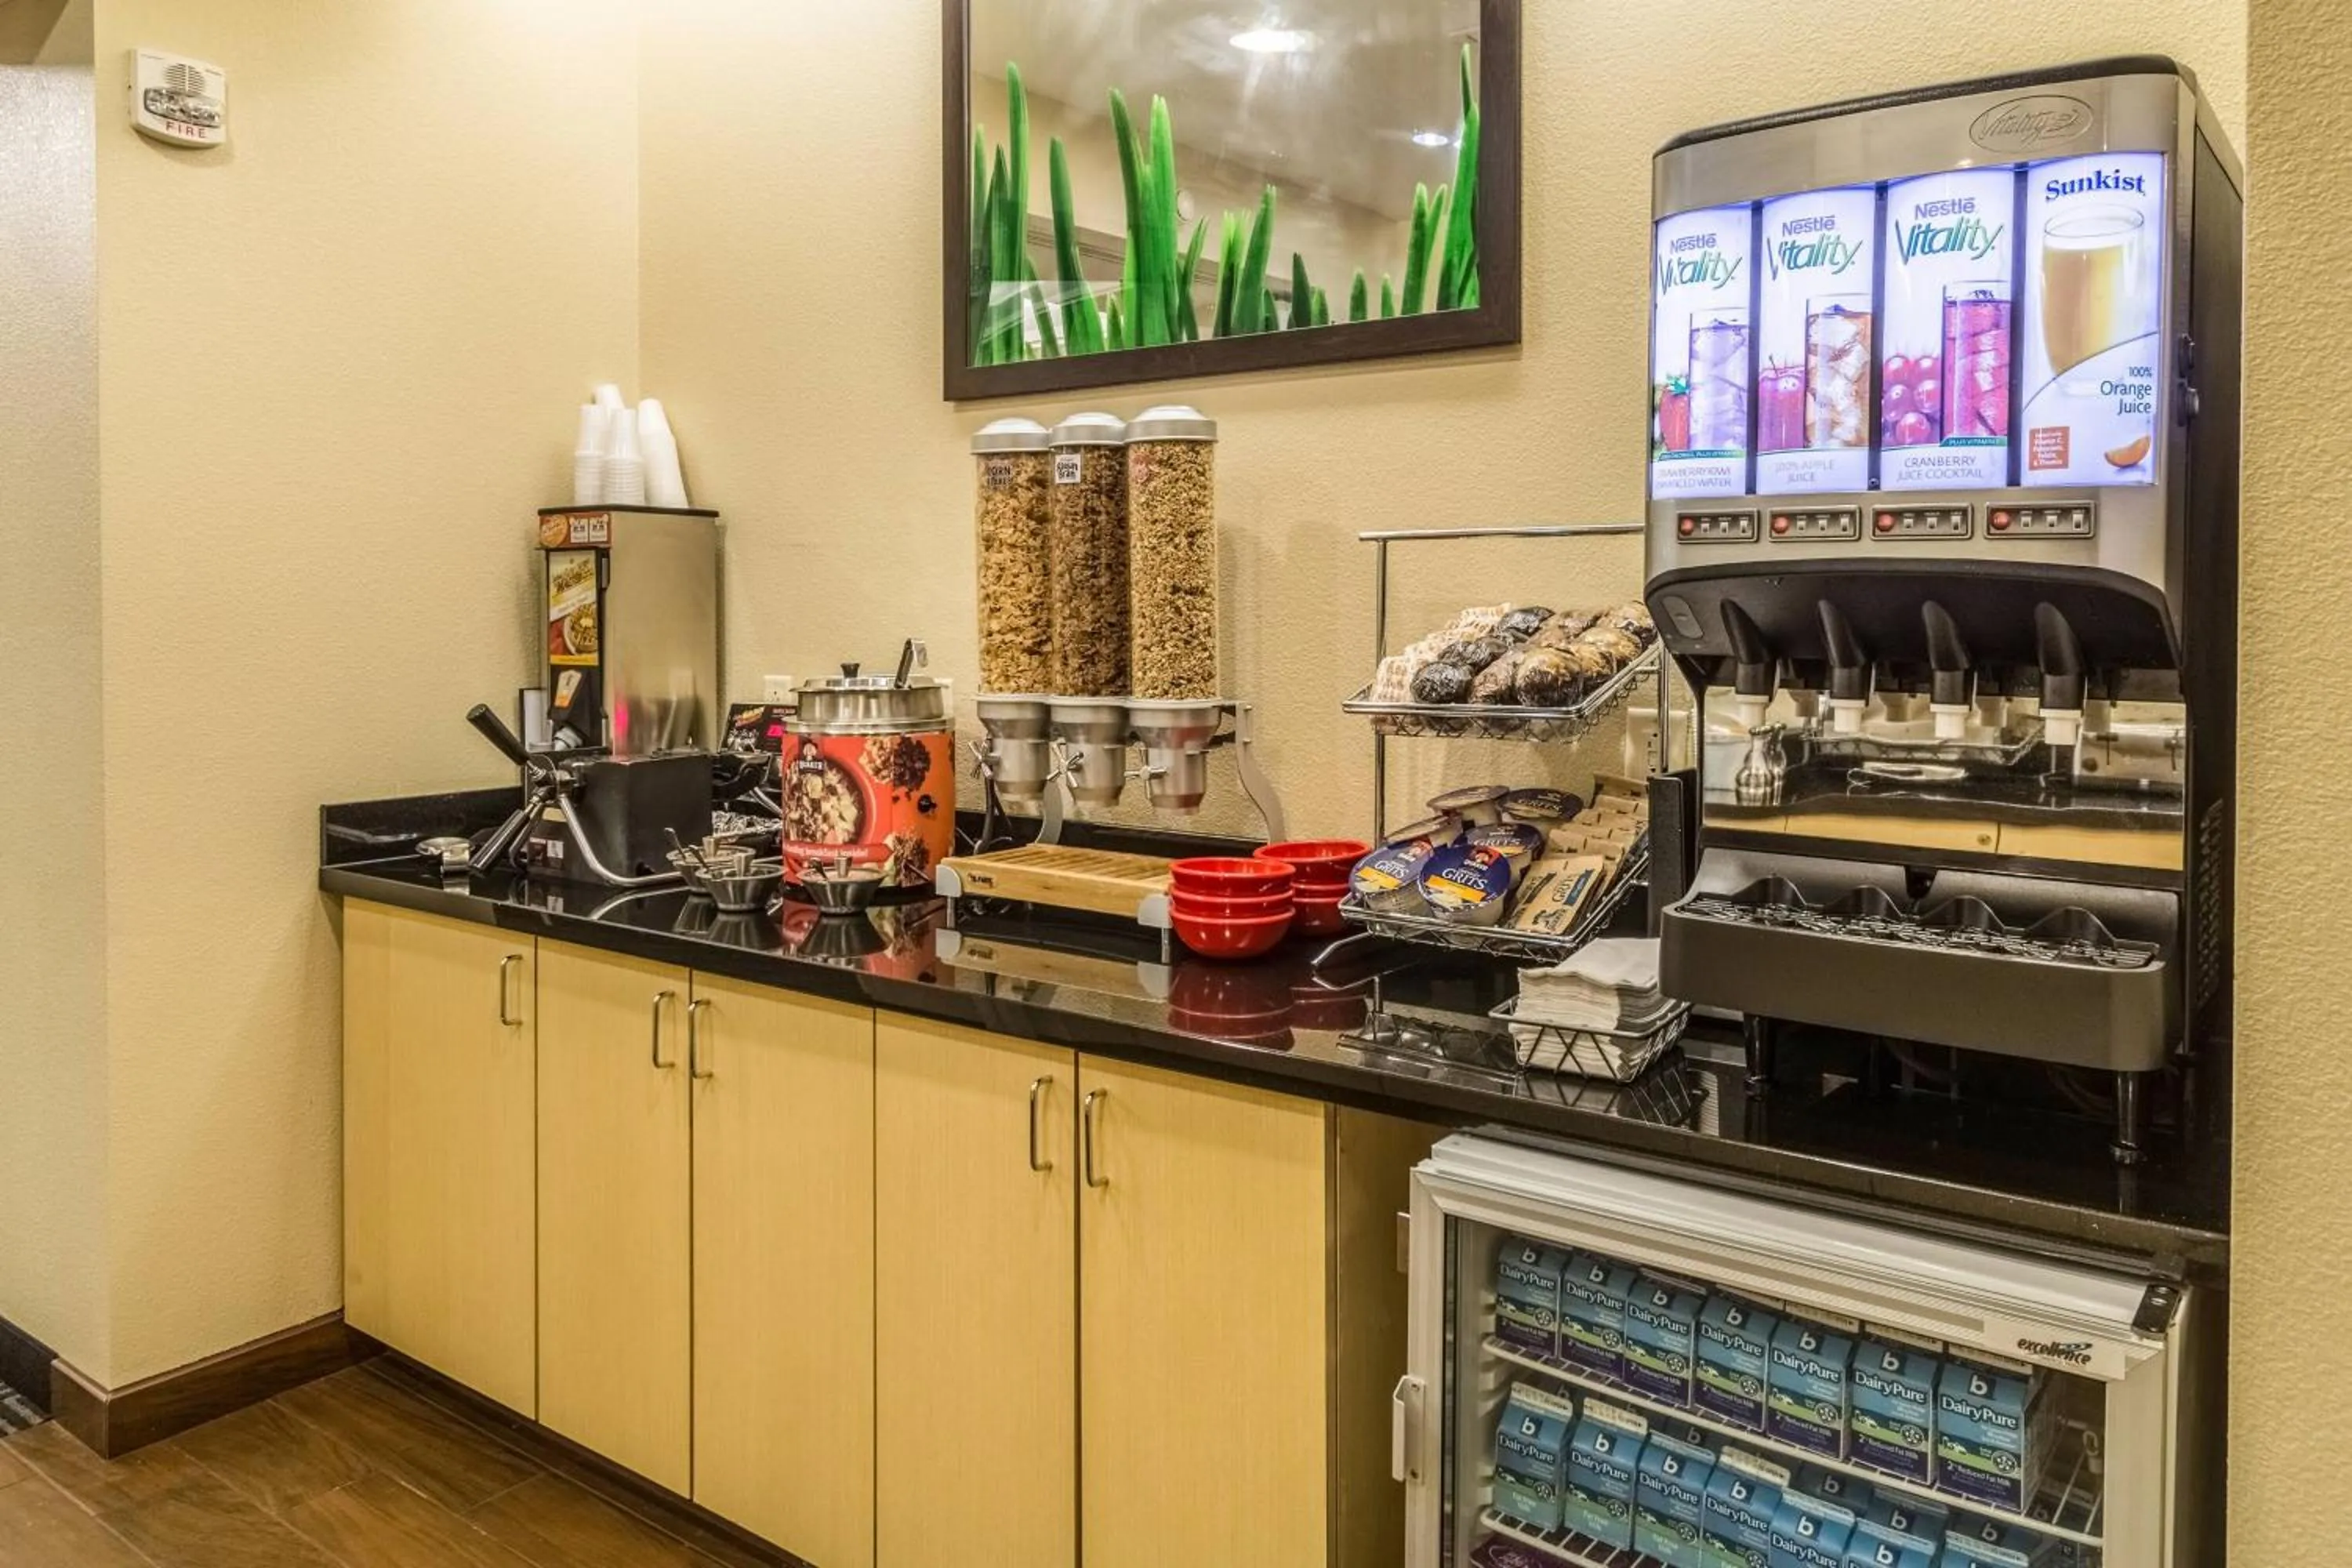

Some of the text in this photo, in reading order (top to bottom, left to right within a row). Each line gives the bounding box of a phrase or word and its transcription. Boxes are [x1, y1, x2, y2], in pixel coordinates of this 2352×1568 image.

[165, 121, 207, 139] FIRE
[2045, 169, 2146, 202] Sunkist
[2129, 366, 2152, 377] 100%
[2100, 380, 2152, 400] Orange
[2117, 398, 2152, 416] Juice
[1896, 469, 1984, 482] JUICE COCKTAIL
[1904, 456, 1976, 468] CRANBERRY
[1374, 860, 1409, 880] GRITS
[1442, 868, 1489, 890] GRITS
[1500, 1264, 1555, 1290] DairyPure
[1566, 1282, 1623, 1310] DairyPure
[1628, 1305, 1688, 1334] DairyPure
[1700, 1324, 1762, 1356] DairyPure
[2017, 1338, 2092, 1365] excellence
[1773, 1350, 1839, 1382] DairyPure
[1856, 1371, 1926, 1403] DairyPure
[1942, 1396, 2017, 1428] DairyPure
[1500, 1436, 1554, 1464] DairyPure
[1572, 1452, 1628, 1481] DairyPure
[1639, 1473, 1698, 1504] DairyPure
[1707, 1498, 1767, 1530] DairyPure
[1773, 1534, 1838, 1567] DairyPure
